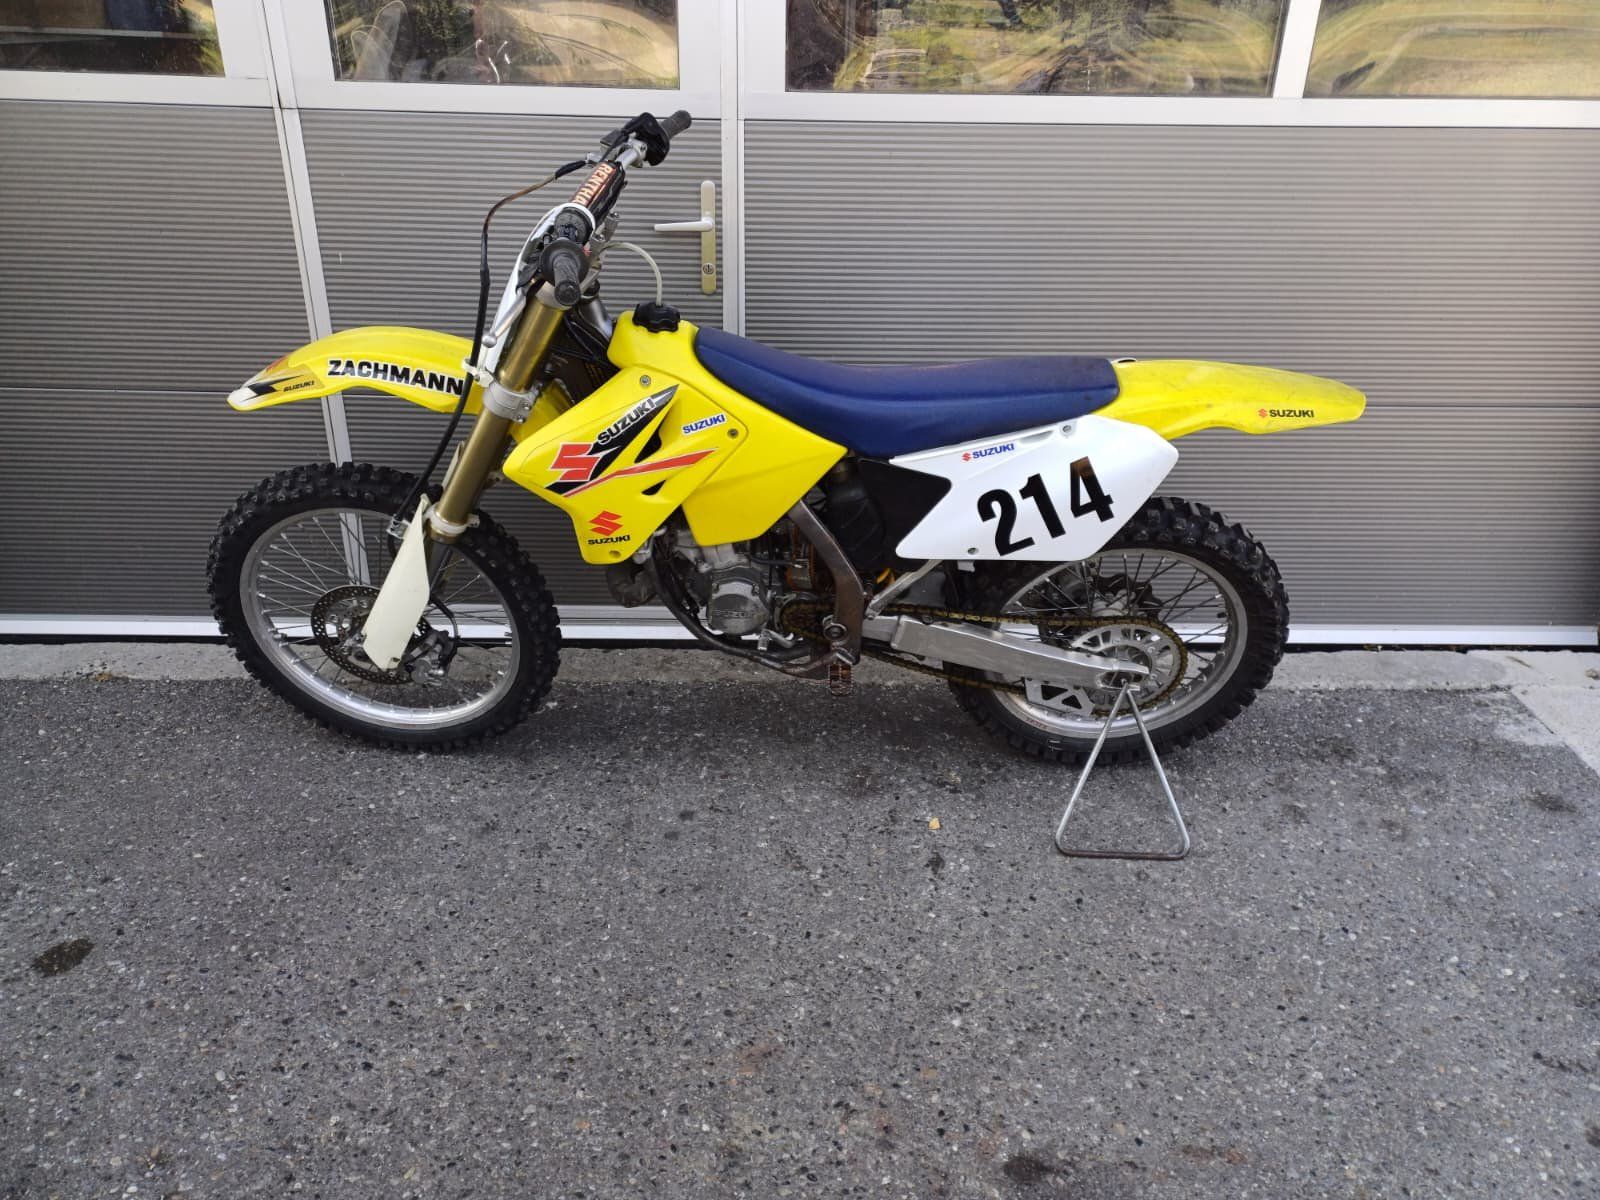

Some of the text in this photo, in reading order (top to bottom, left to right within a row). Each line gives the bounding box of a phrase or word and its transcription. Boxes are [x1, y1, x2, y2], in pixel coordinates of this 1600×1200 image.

[327, 359, 464, 395] ZACHMANN
[283, 380, 316, 393] SUZUKI
[597, 398, 656, 445] SUZUKI
[1269, 408, 1315, 418] SUZUKI
[682, 414, 726, 434] SUZUKI
[972, 443, 1015, 459] SUZUKI
[977, 456, 1115, 556] 214
[587, 534, 631, 545] SUZUKI
